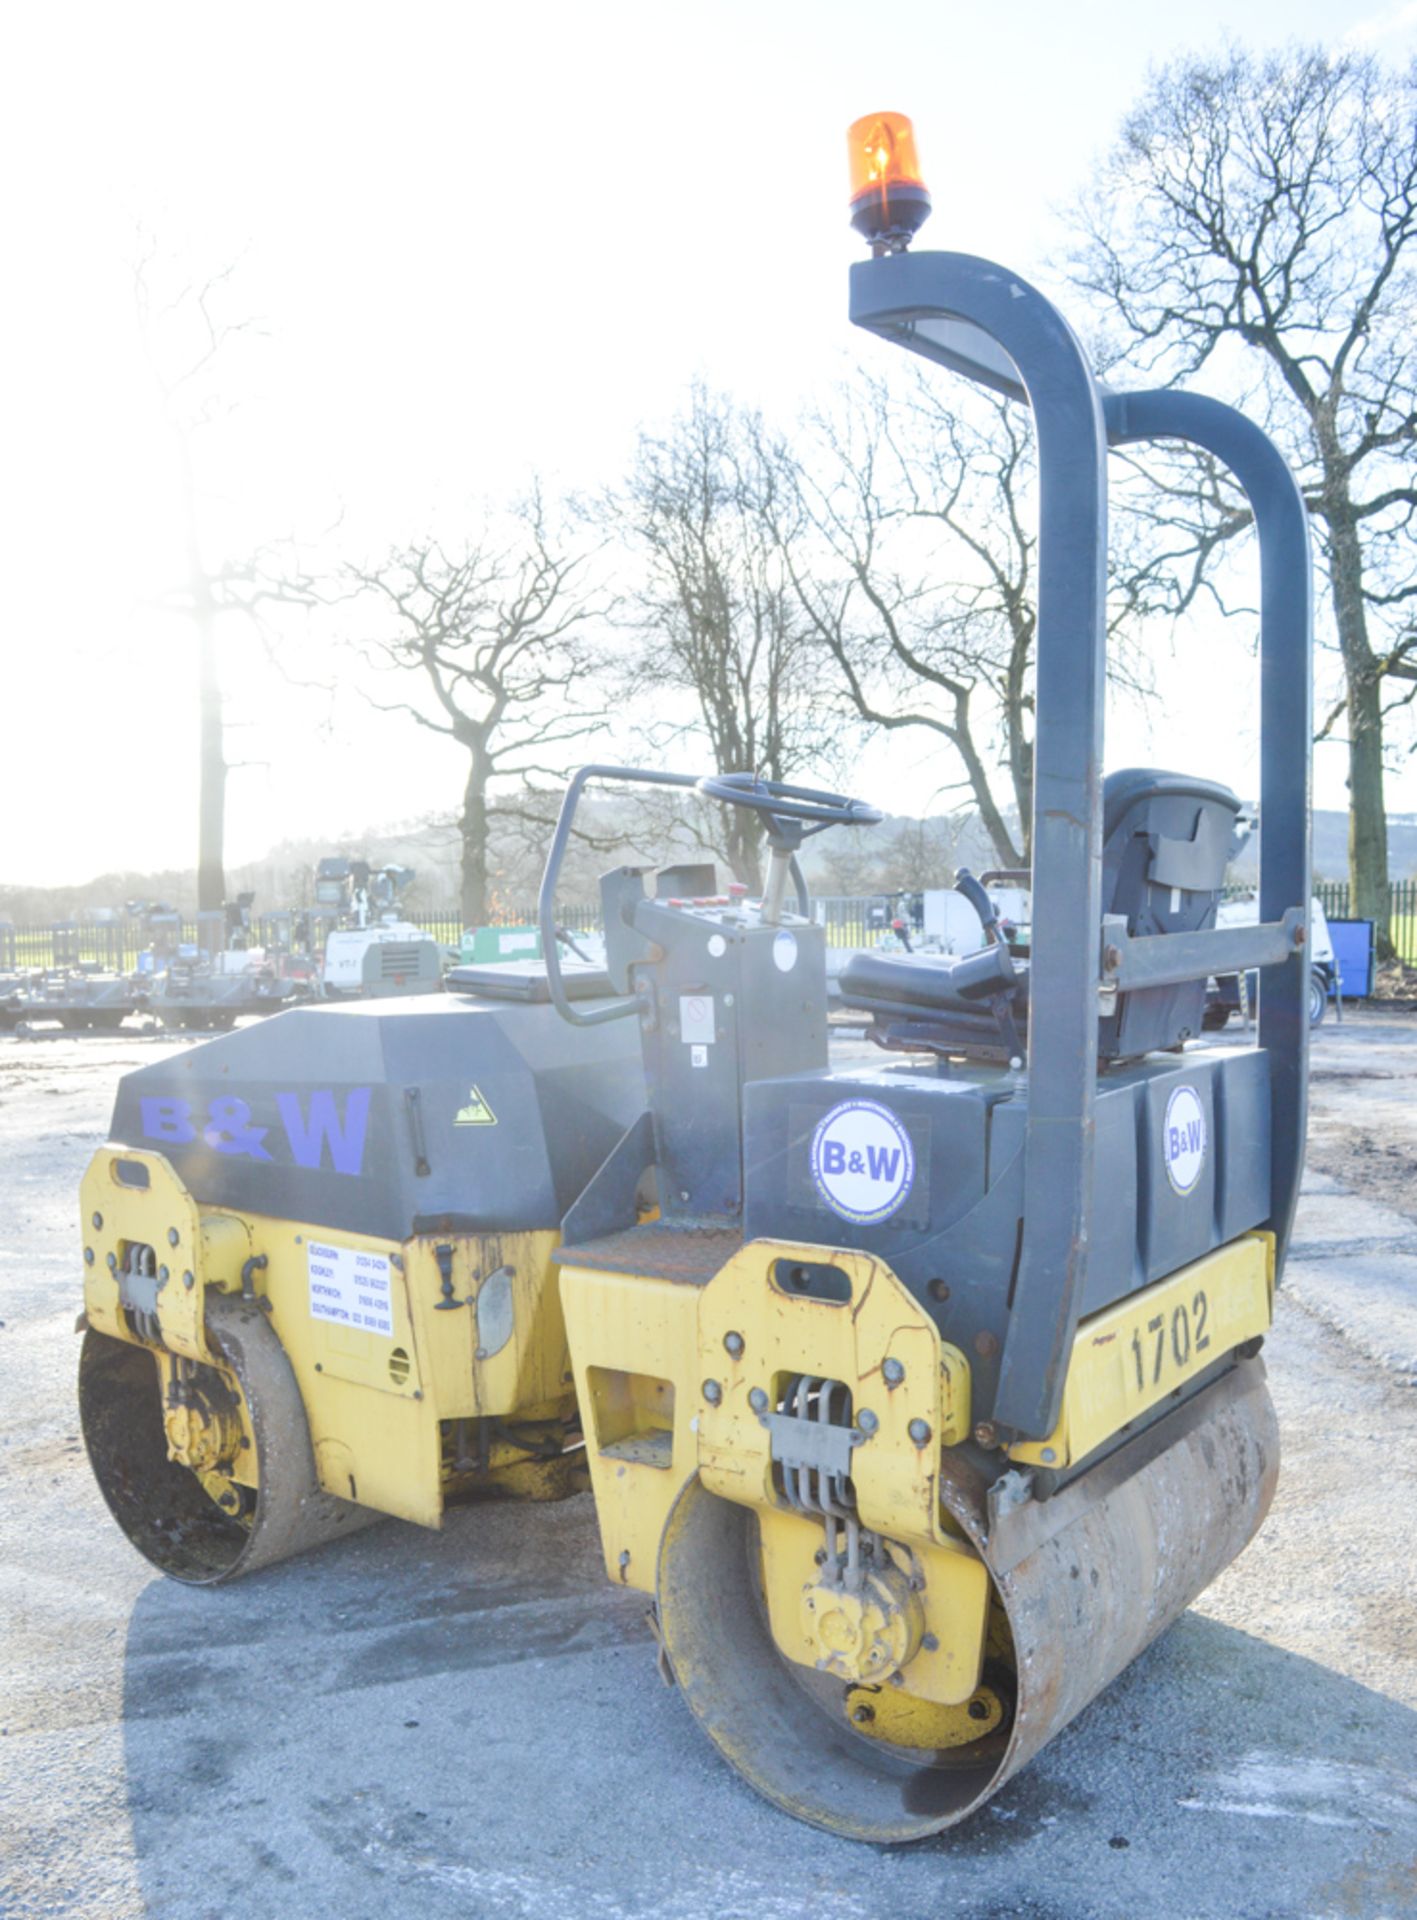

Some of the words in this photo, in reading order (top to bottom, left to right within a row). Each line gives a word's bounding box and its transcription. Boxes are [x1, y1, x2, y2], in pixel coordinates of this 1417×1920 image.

[139, 1087, 371, 1176] B&W
[823, 1140, 901, 1183] B&W
[1168, 1119, 1201, 1161] B&W
[1131, 1289, 1210, 1393] 1702
